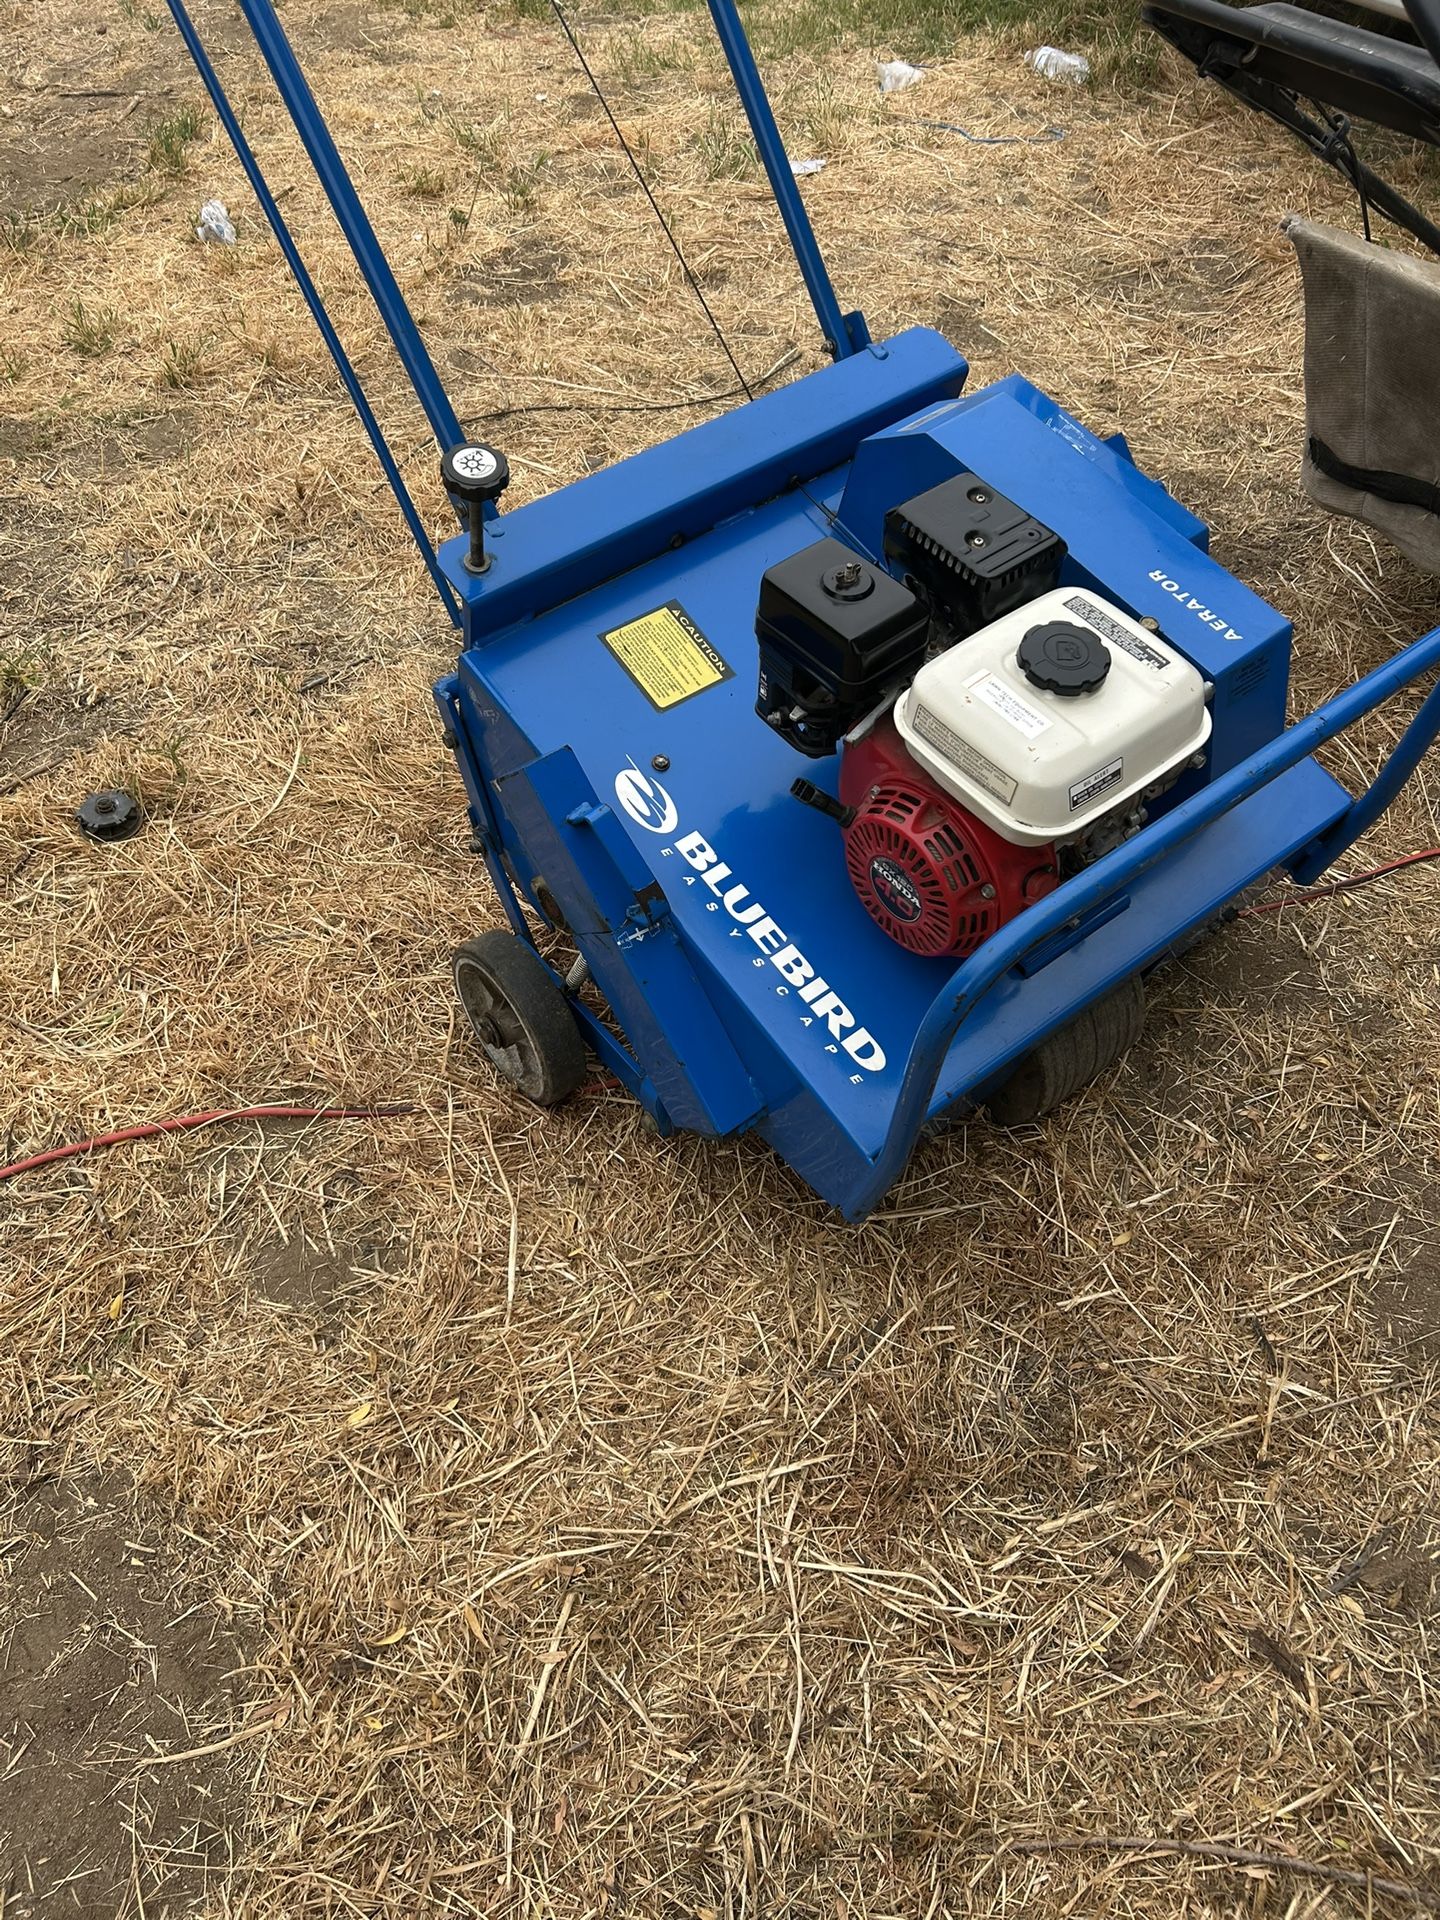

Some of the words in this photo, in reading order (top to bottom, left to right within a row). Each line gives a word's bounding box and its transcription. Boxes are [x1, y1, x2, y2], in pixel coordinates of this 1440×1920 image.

[1148, 569, 1245, 640] AERATOR
[679, 616, 725, 671] CAUTION
[872, 860, 921, 909] HONDA
[673, 830, 887, 1072] BLUEBIRD
